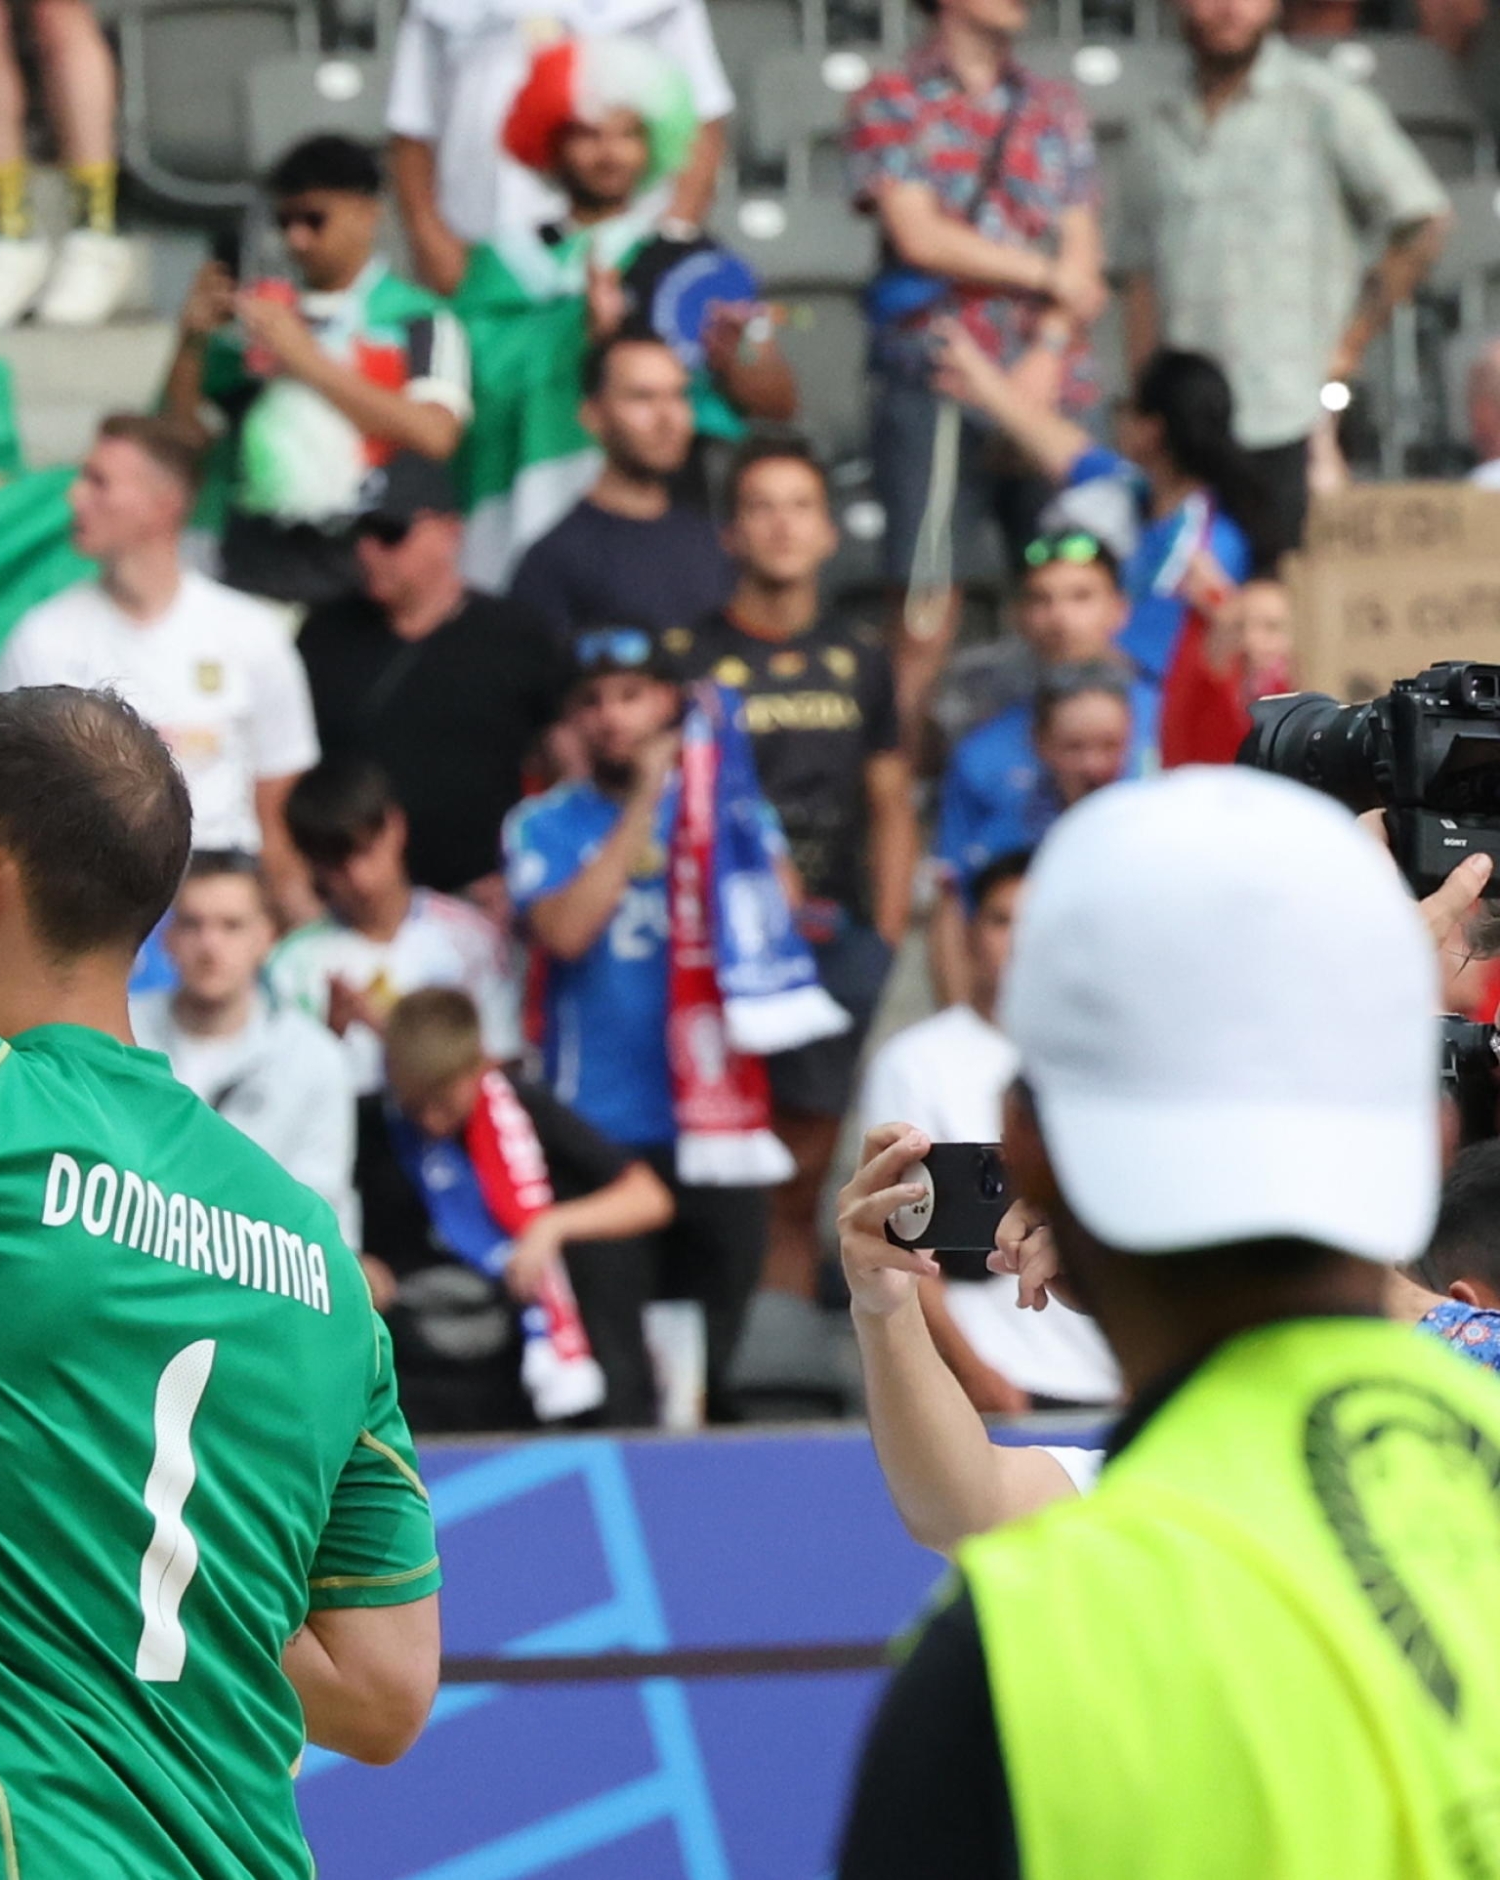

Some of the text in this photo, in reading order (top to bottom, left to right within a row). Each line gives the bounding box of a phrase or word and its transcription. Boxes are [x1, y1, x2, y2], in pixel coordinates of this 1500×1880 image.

[1443, 837, 1468, 847] SONY
[42, 1152, 331, 1315] DONNARUMMA
[135, 1338, 216, 1682] 1
